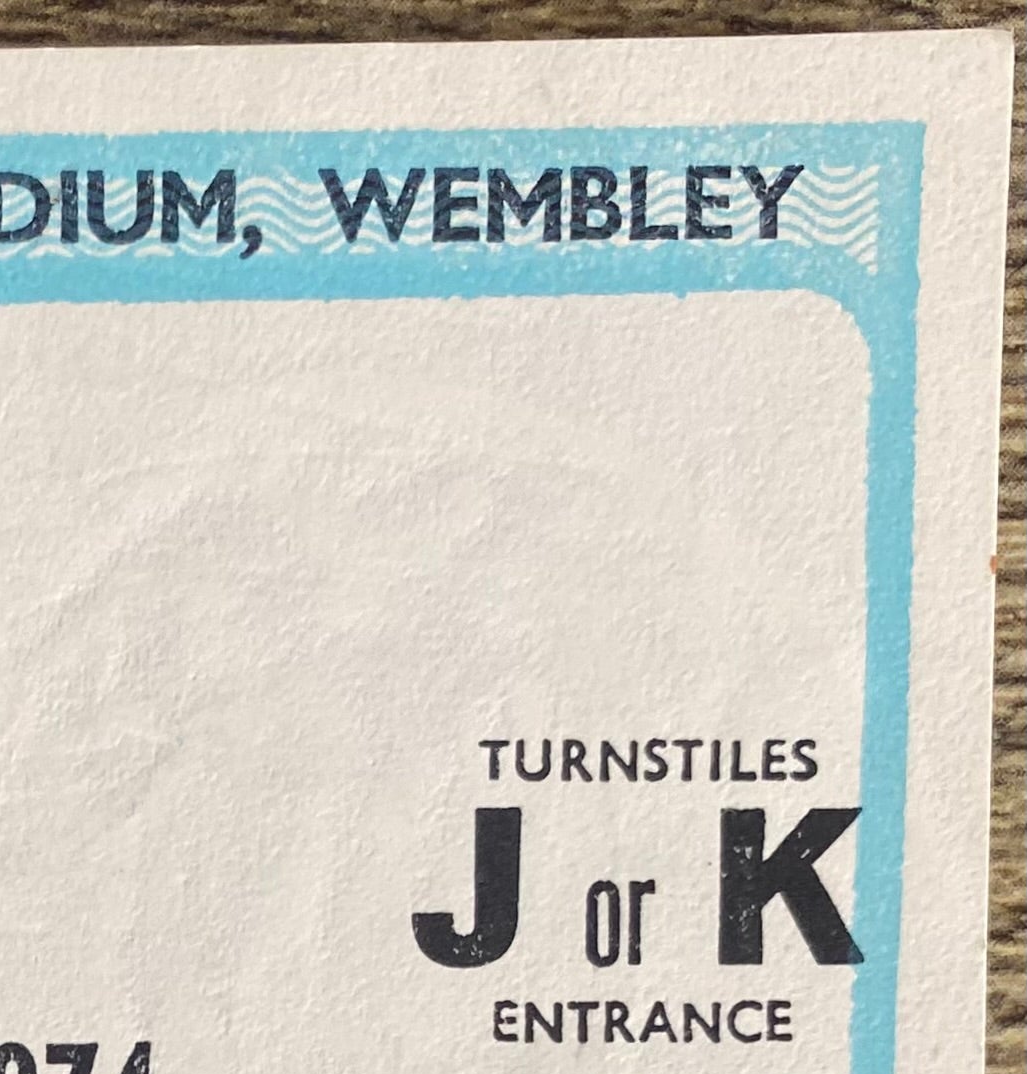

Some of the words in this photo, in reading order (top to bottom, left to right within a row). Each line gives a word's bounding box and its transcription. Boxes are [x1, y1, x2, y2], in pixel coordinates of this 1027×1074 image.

[320, 165, 804, 242] WEMBLEY
[479, 739, 817, 781] TURNSTILES
[412, 807, 522, 968] J
[586, 880, 655, 967] or
[719, 807, 864, 965] K
[494, 1000, 792, 1043] ENTRANCE
